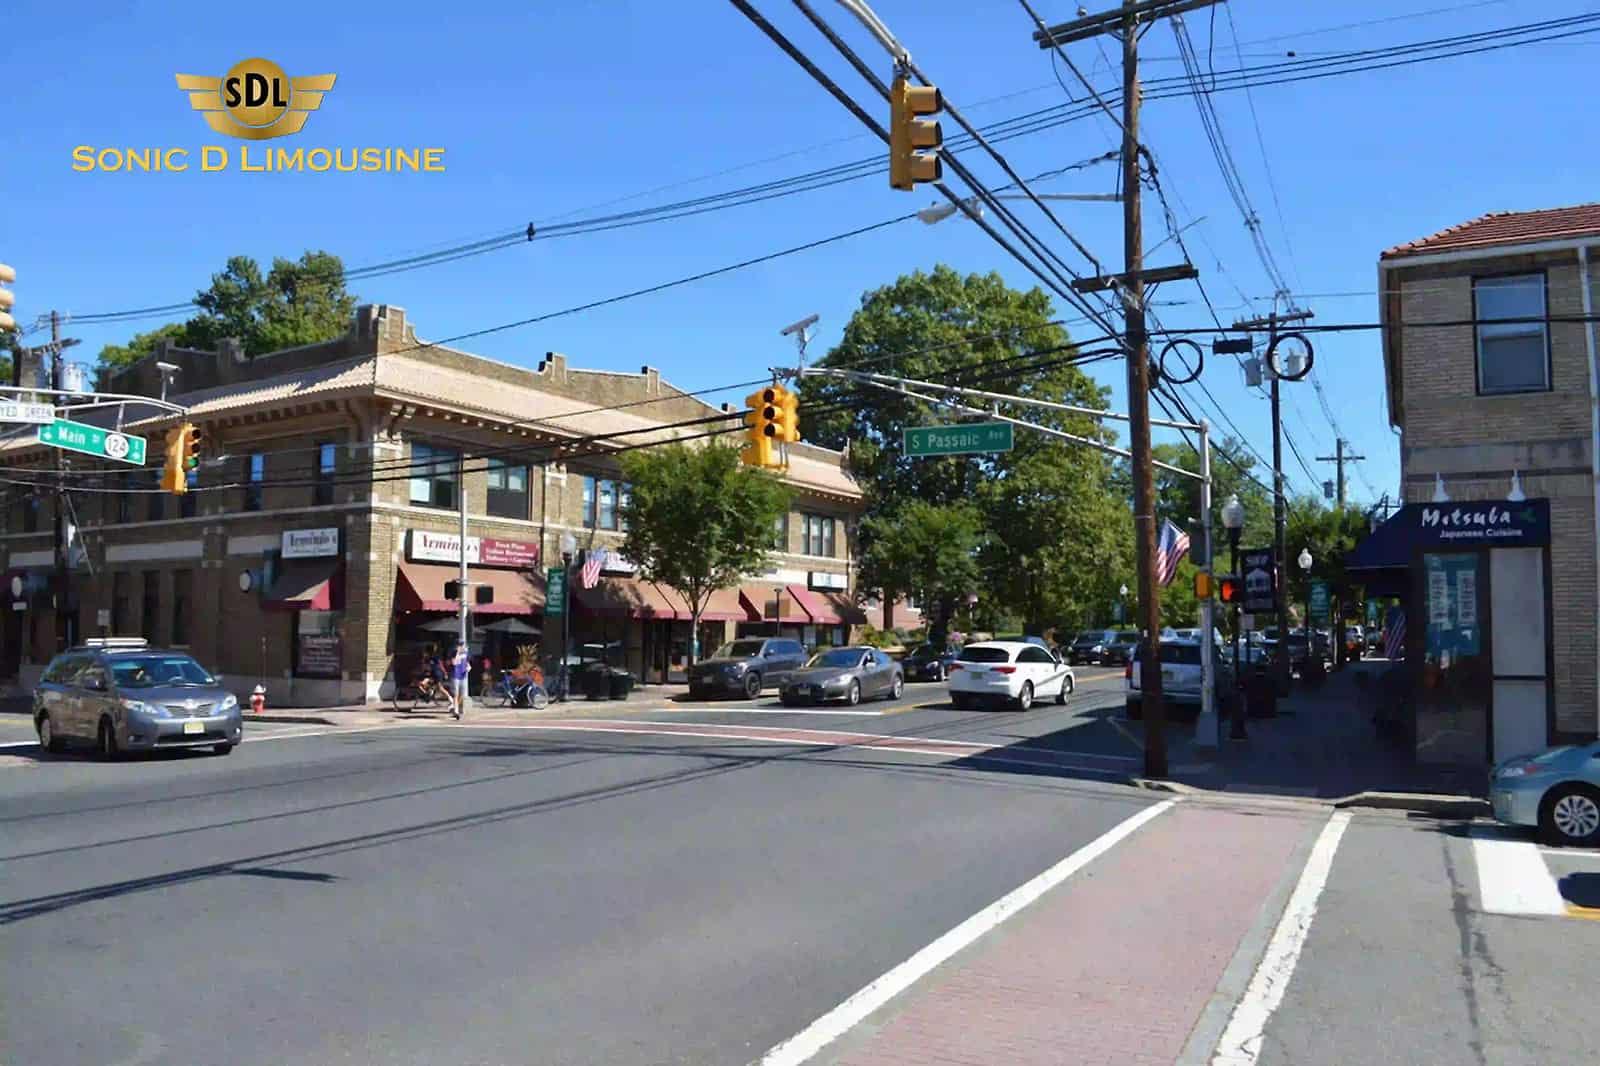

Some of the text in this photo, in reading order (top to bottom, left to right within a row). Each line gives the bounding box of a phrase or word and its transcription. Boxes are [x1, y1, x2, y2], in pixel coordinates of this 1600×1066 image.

[58, 427, 86, 445] Main
[107, 438, 127, 454] 124
[911, 434, 920, 449] S
[927, 432, 981, 449] Passaic
[1486, 528, 1522, 537] Cuisine
